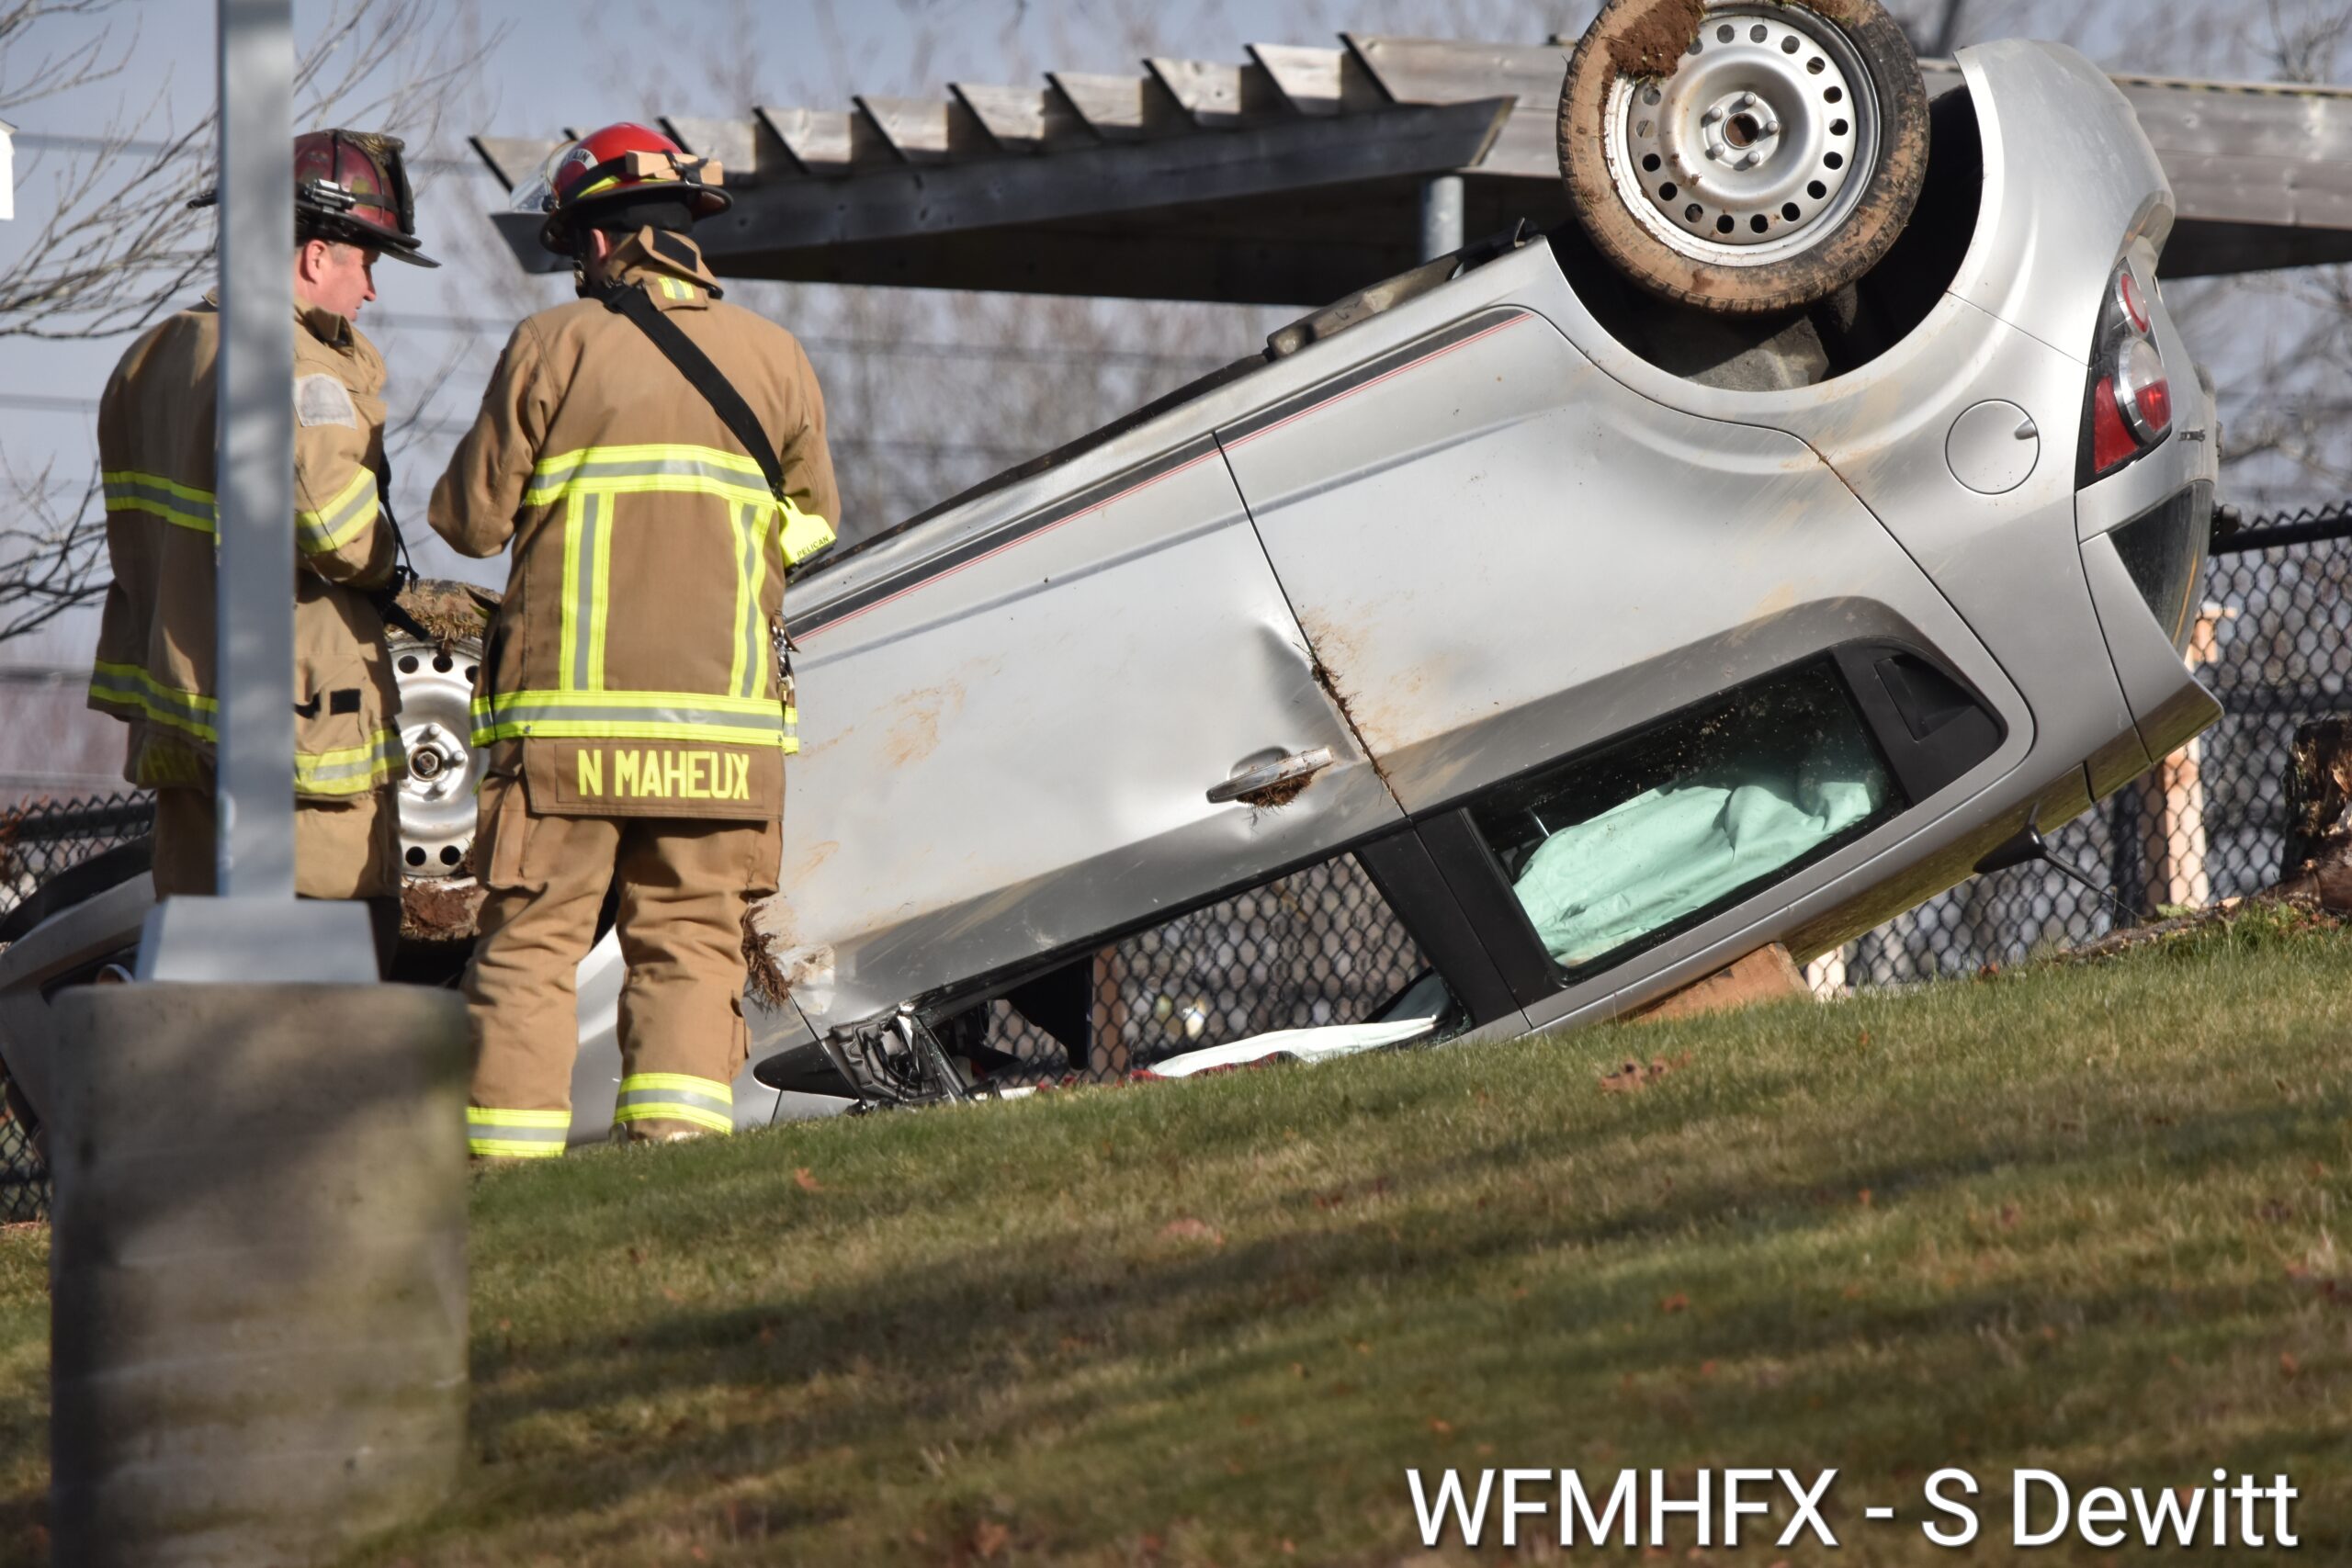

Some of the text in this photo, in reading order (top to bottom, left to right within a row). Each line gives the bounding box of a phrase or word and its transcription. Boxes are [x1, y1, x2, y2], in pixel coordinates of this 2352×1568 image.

[797, 536, 830, 558] PELICAN
[577, 749, 751, 801] N MAHEUX
